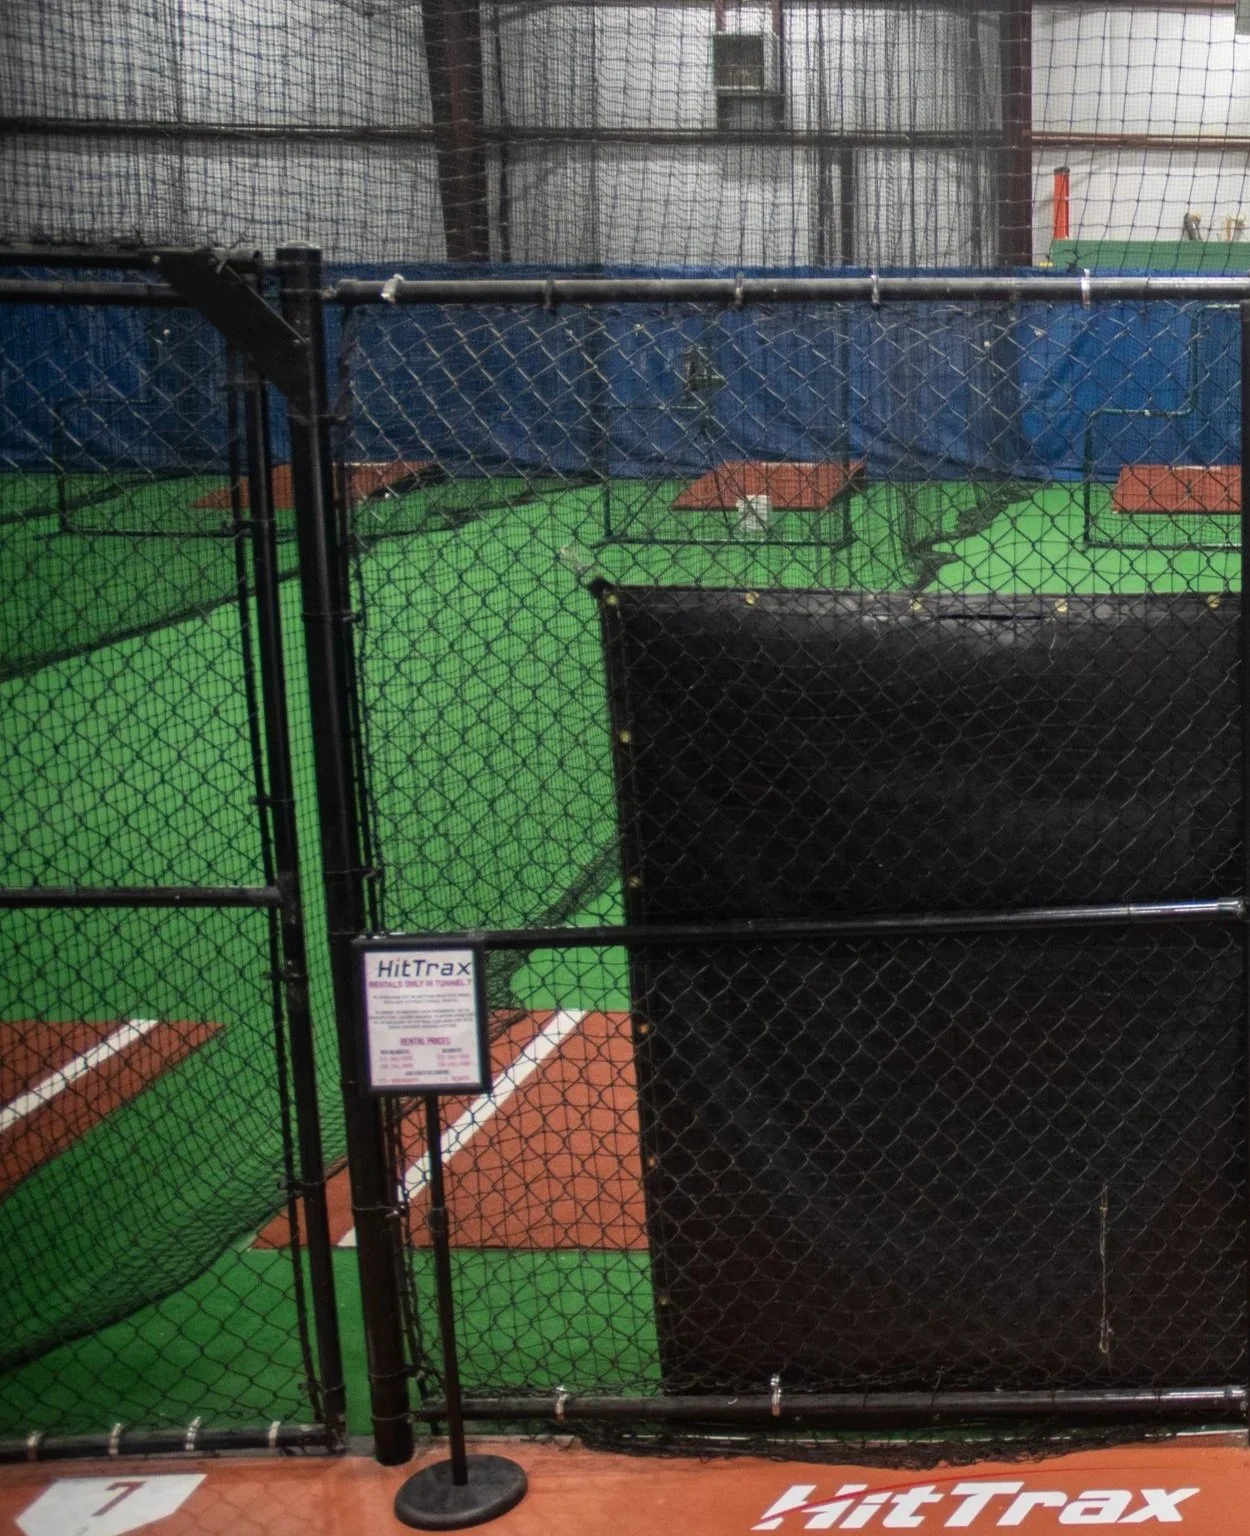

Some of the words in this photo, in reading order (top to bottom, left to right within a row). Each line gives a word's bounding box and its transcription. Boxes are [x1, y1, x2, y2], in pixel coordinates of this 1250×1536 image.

[378, 960, 471, 977] HitTrax
[368, 980, 403, 988] RENTALS
[404, 980, 424, 988] ONLY
[90, 1481, 147, 1517] 7
[750, 1481, 1201, 1531] HitTrax
